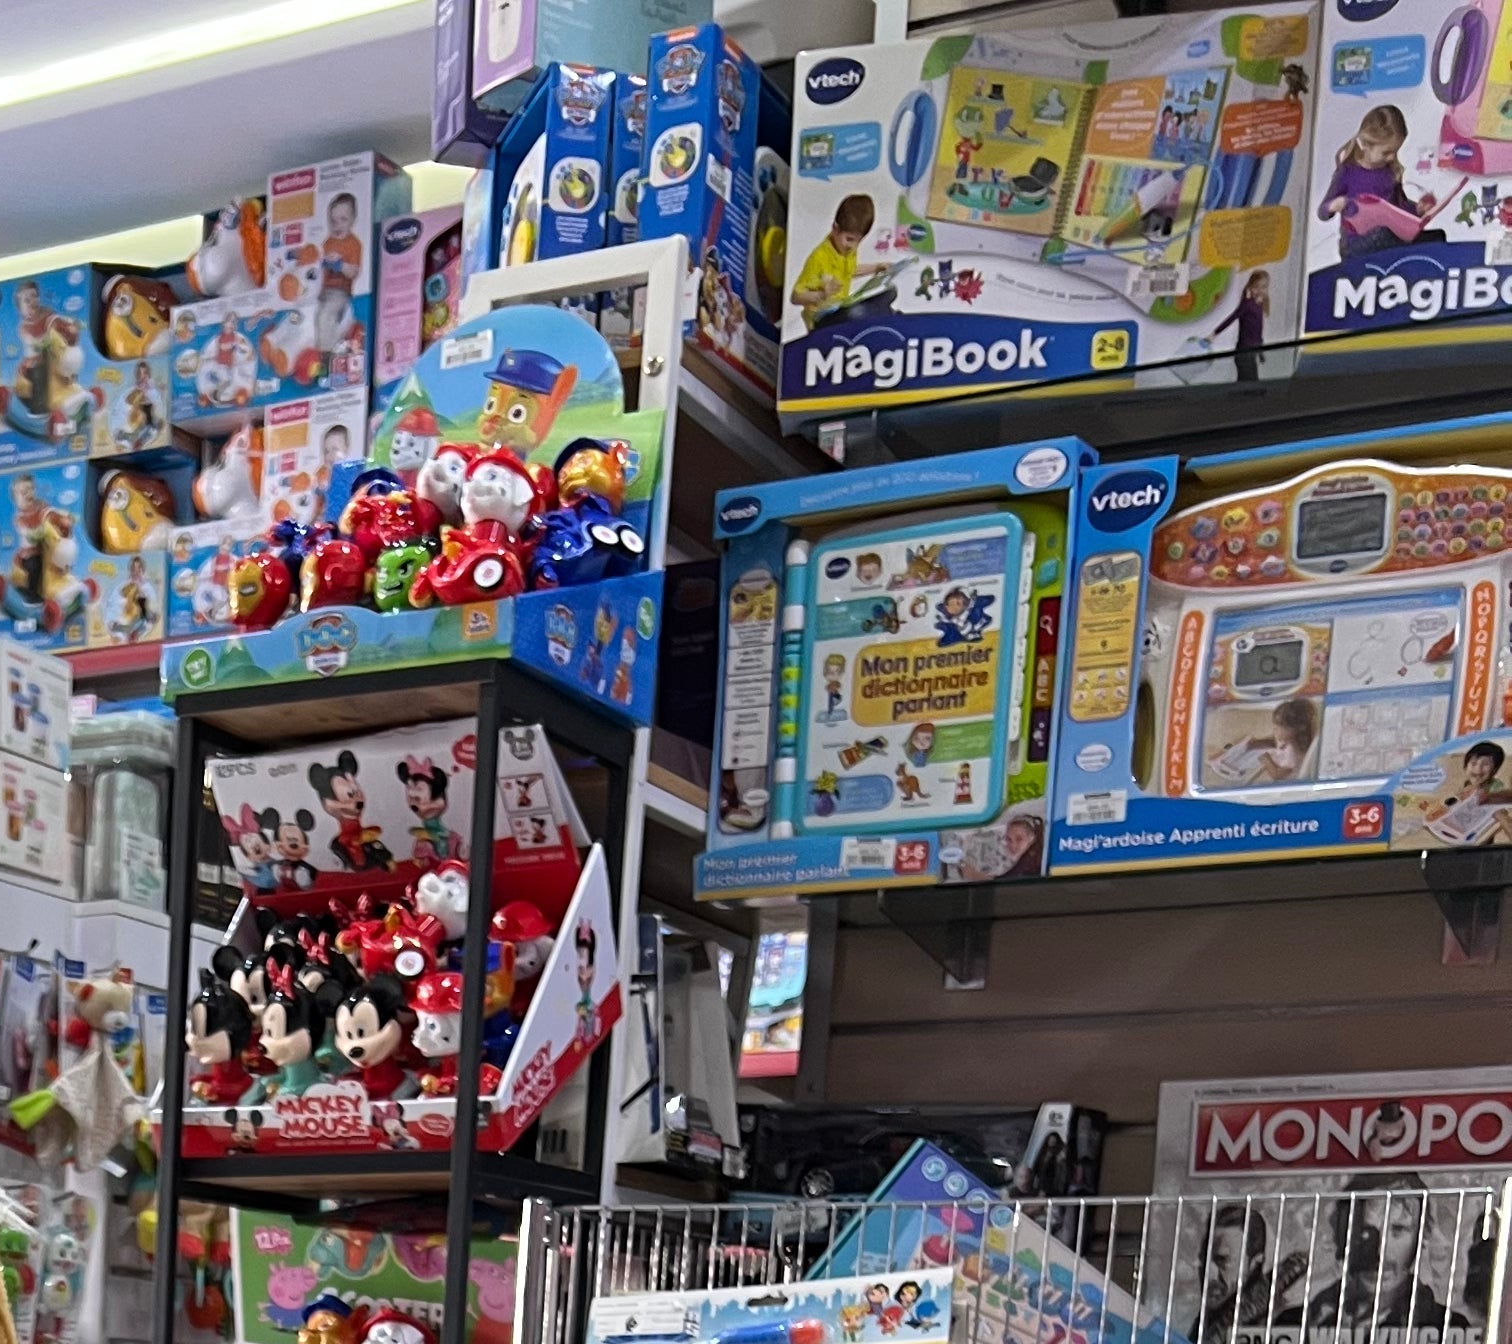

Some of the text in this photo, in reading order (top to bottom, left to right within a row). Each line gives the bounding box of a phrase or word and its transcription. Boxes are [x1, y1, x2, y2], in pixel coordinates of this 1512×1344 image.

[808, 70, 861, 90] vtech
[805, 329, 1047, 388] MagiBook
[1092, 484, 1161, 512] vtech
[861, 647, 993, 677] Mon premier
[861, 668, 989, 699] dictionnaire
[892, 690, 968, 720] parlant
[1169, 822, 1245, 845] Apprenti
[1250, 817, 1319, 836] écriture
[275, 1095, 362, 1115] MICKEY
[283, 1115, 367, 1138] MOUSE
